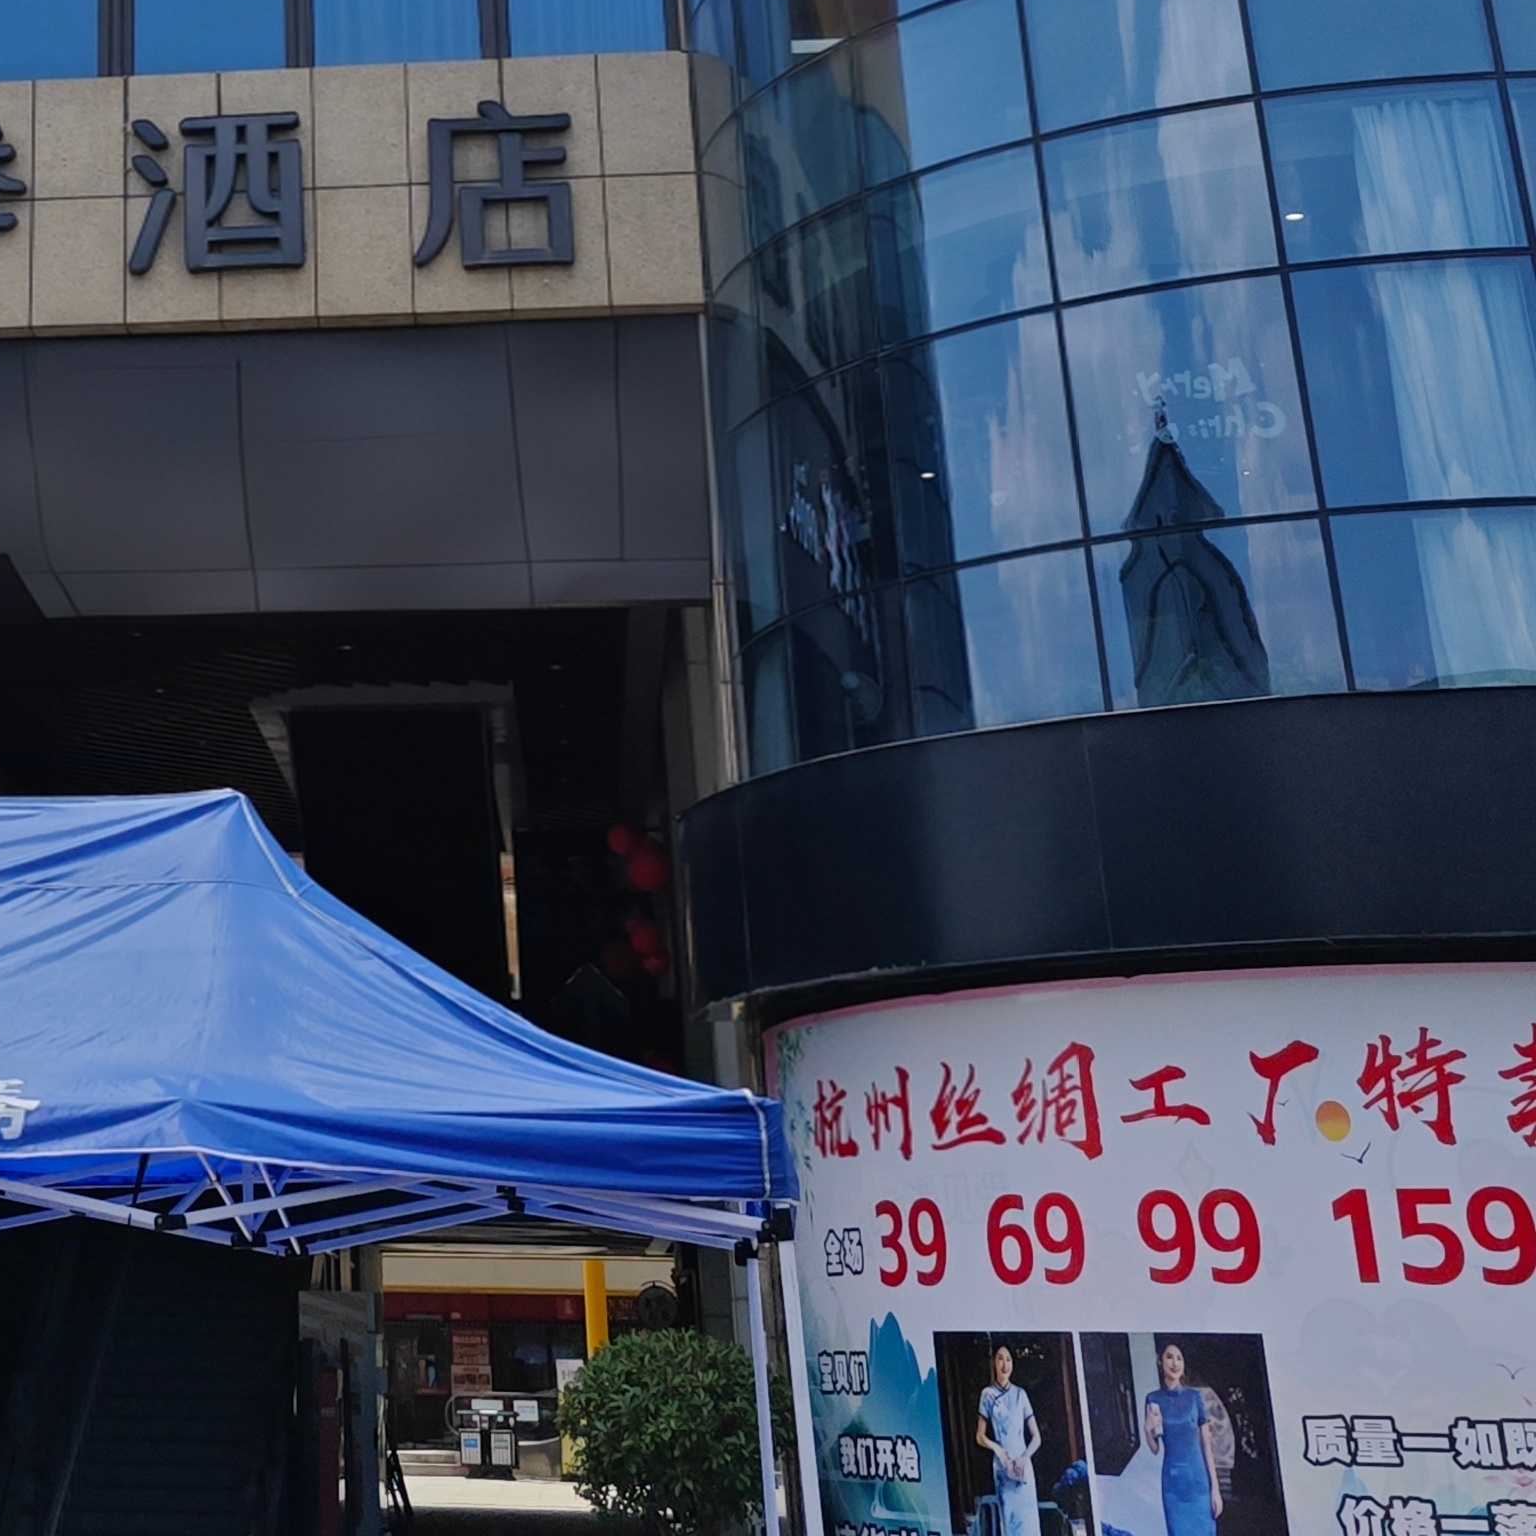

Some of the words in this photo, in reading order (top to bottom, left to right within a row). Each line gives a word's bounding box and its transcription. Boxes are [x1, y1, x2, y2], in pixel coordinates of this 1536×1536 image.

[823, 1227, 865, 1277] 全场
[875, 1198, 947, 1287] 39
[986, 1191, 1085, 1286] 69
[1136, 1188, 1262, 1285] 99
[1331, 1186, 1536, 1286] 159
[818, 1349, 871, 1396] 宝贝们
[838, 1432, 922, 1483] 我们开始
